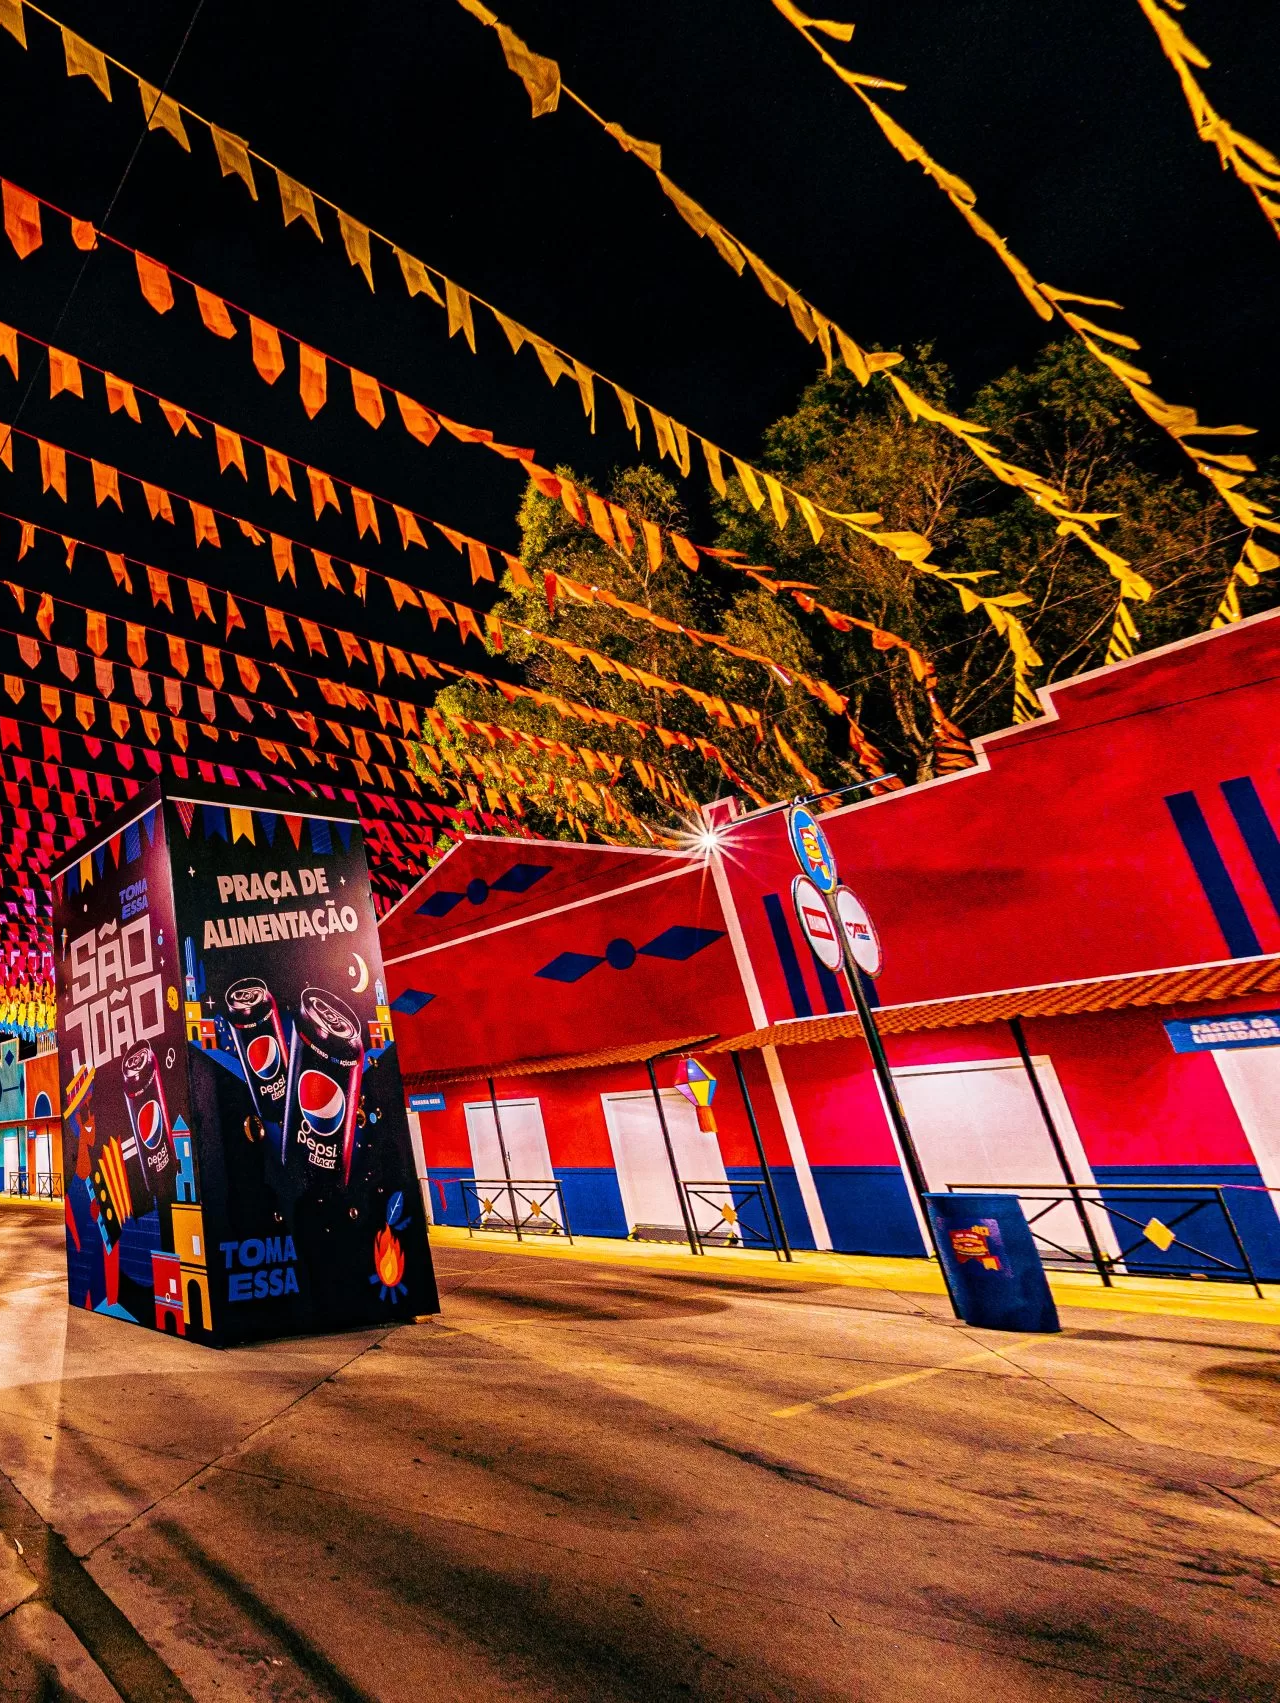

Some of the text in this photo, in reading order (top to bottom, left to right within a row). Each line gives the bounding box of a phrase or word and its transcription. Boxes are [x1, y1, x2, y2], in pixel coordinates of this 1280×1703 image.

[119, 878, 148, 904] TOMA
[217, 867, 330, 905] PRAÇA DE
[122, 895, 149, 920] ESSA
[203, 900, 359, 950] ALIMENTAÇÃO
[70, 914, 154, 1005] SÃO
[64, 973, 165, 1078] JOÃO
[260, 1074, 286, 1096] pepsi
[148, 1142, 167, 1167] pepsi
[297, 1130, 337, 1158] pepsi
[309, 1153, 335, 1169] BLACK
[220, 1235, 298, 1269] TOMA
[228, 1267, 299, 1302] ESSA
